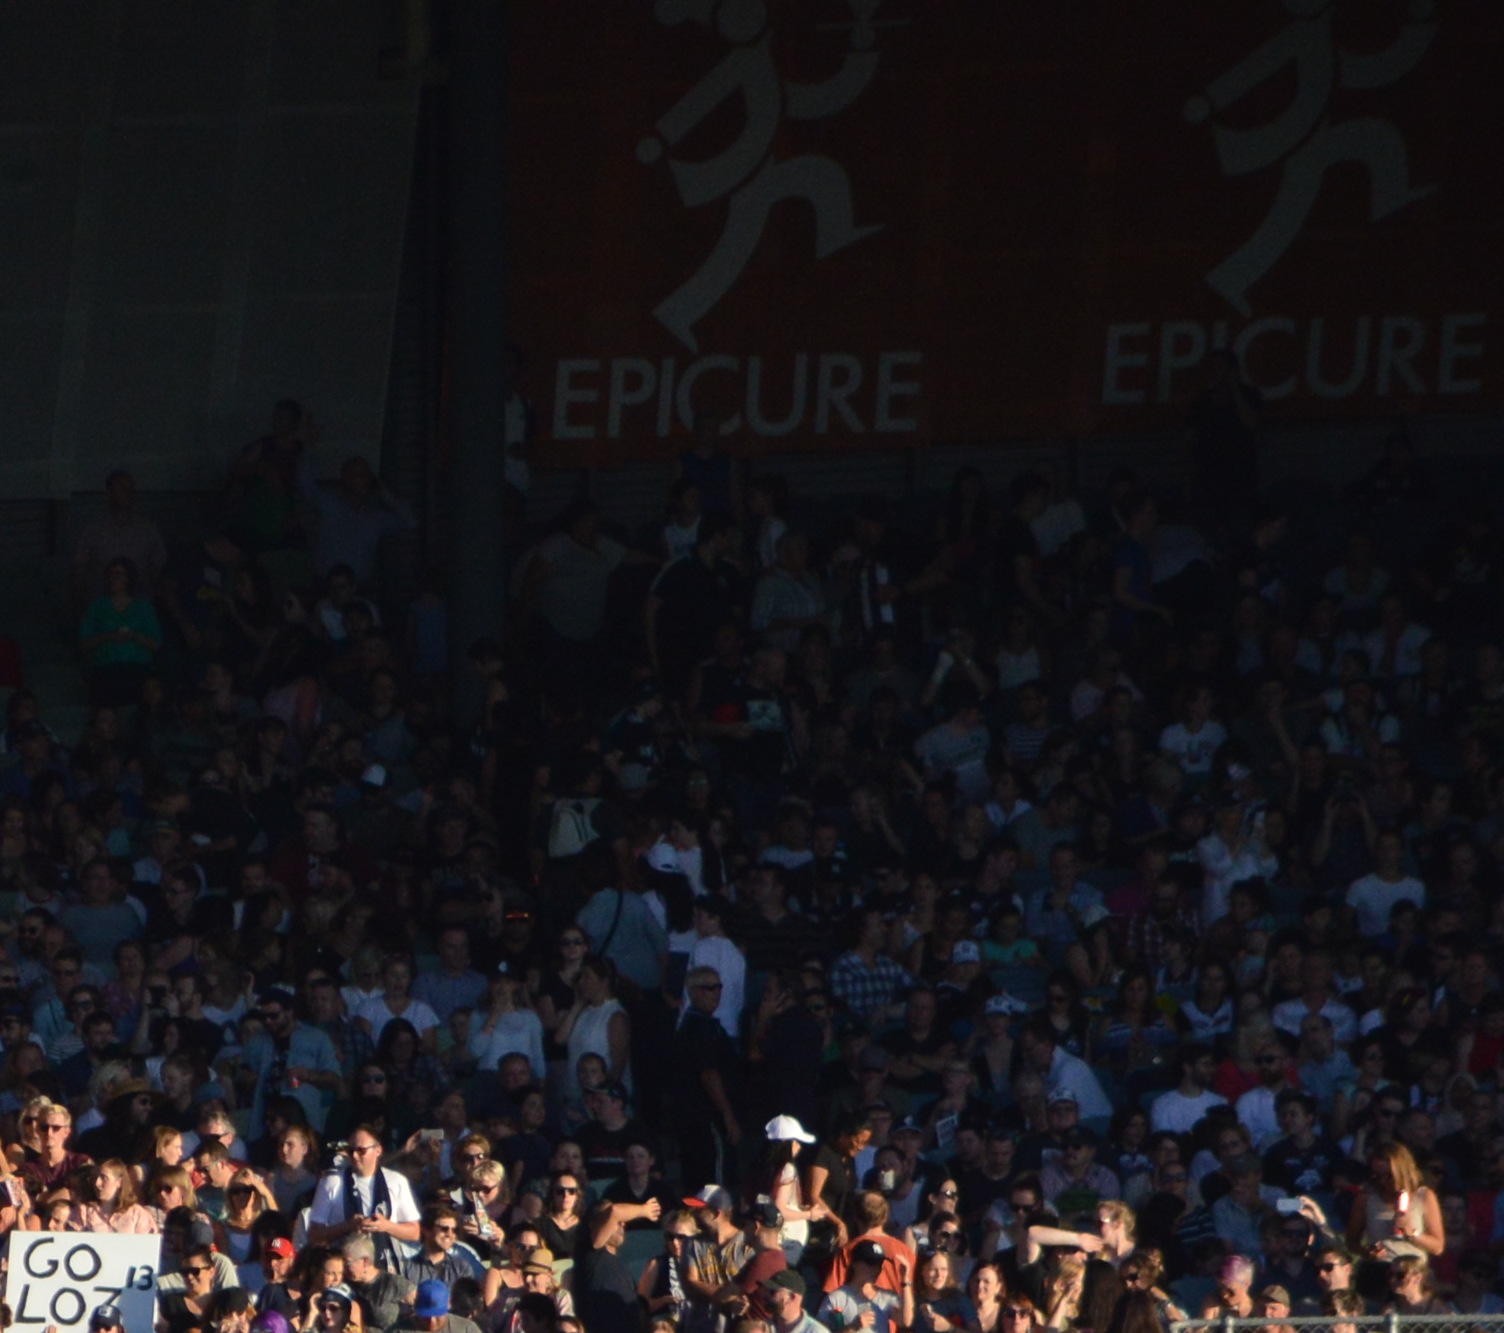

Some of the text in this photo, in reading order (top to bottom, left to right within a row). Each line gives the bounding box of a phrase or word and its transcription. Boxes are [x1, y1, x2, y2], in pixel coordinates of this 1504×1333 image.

[550, 348, 923, 440] EPICURE
[23, 1237, 102, 1283] GO
[125, 1264, 154, 1292] 13
